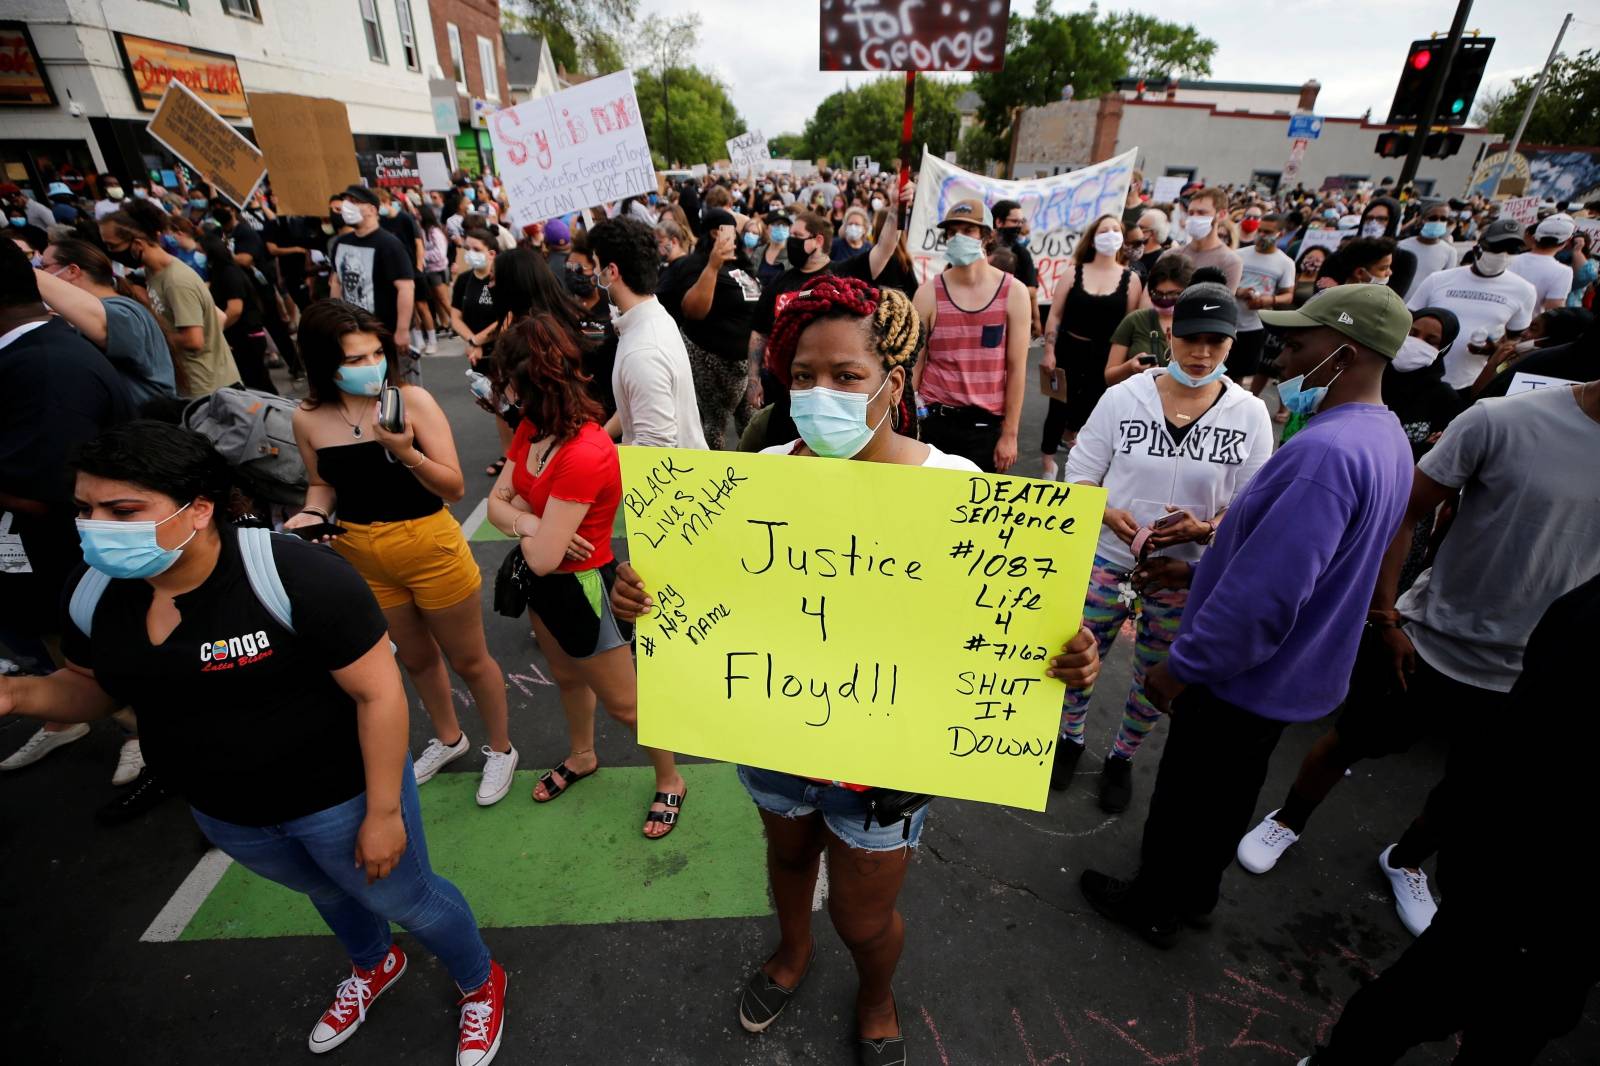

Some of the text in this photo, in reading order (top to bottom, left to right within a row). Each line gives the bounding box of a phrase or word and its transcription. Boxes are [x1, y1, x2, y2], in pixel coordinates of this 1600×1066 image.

[859, 26, 994, 71] George
[1120, 419, 1247, 465] PINK
[624, 456, 694, 518] BLACK
[968, 477, 1071, 507] DEATH
[741, 520, 923, 581] Justice
[998, 526, 1014, 549] 4
[949, 539, 1058, 580] #1087
[975, 583, 1043, 610] Life
[801, 595, 827, 642] 4
[995, 610, 1012, 635] 4
[201, 661, 235, 673] Latin
[963, 633, 1048, 662] #7162
[724, 651, 898, 727] Floyd!!
[955, 671, 1041, 696] SHUT
[947, 726, 1054, 766] DOWN!
